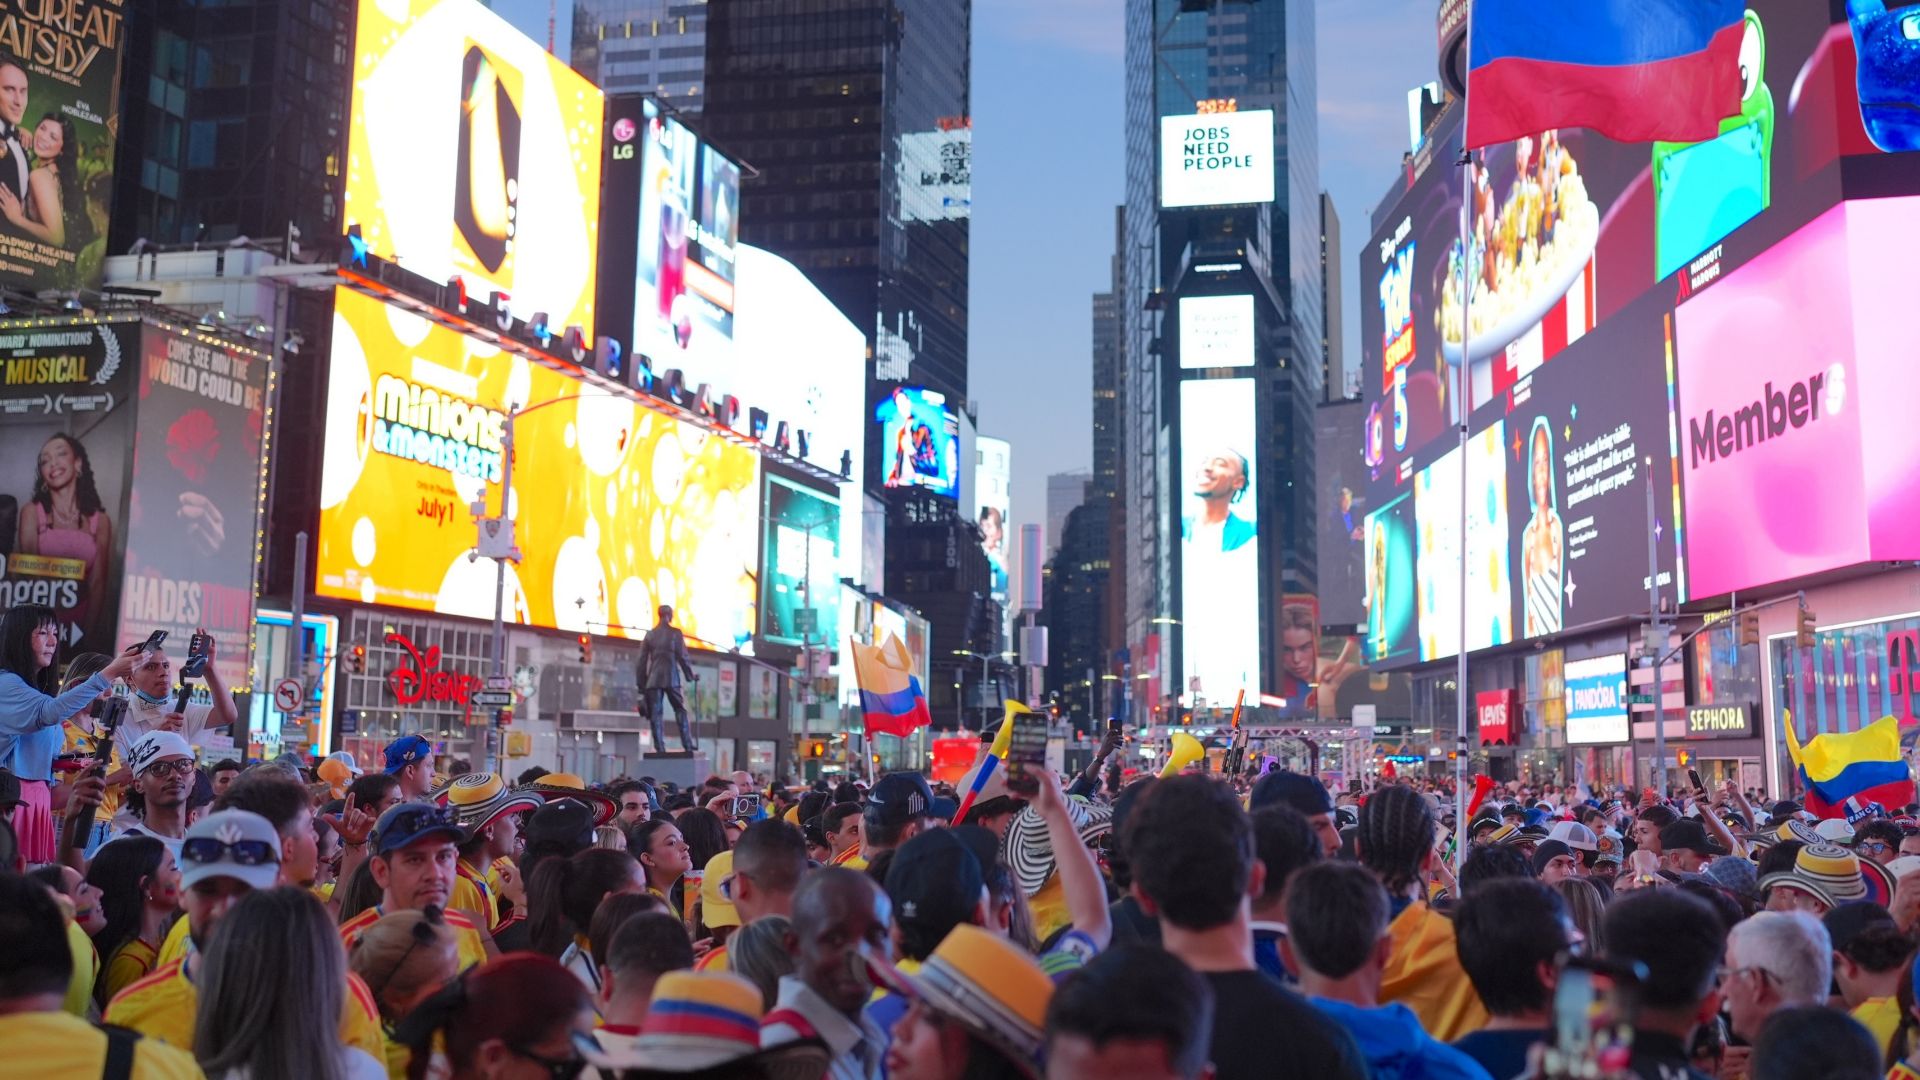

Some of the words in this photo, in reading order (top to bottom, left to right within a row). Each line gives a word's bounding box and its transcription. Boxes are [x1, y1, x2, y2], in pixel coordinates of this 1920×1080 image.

[17, 0, 122, 49] GREAT
[0, 14, 100, 77] ATSBY
[61, 104, 102, 125] NOBLEZADA
[75, 100, 90, 111] EVA
[1184, 127, 1230, 141] JOBS
[1184, 142, 1229, 155] NEED
[613, 145, 633, 159] LG
[1184, 155, 1253, 170] PEOPLE
[1691, 244, 1722, 275] MARRIOTT
[1692, 262, 1719, 290] MARQUIS
[29, 332, 93, 347] NOMINATIONS
[5, 355, 89, 385] MUSICAL
[167, 338, 193, 364] COME
[193, 345, 211, 370] SEE
[232, 357, 250, 381] THE
[448, 275, 587, 363] 1540
[595, 336, 812, 458] BROADWAY
[148, 354, 198, 392] WORLD
[199, 370, 244, 406] COULD
[244, 385, 262, 411] BE
[417, 497, 447, 528] July
[448, 501, 454, 523] 1
[125, 574, 251, 633] HADESTOWN
[1690, 706, 1745, 731] SEPHORA
